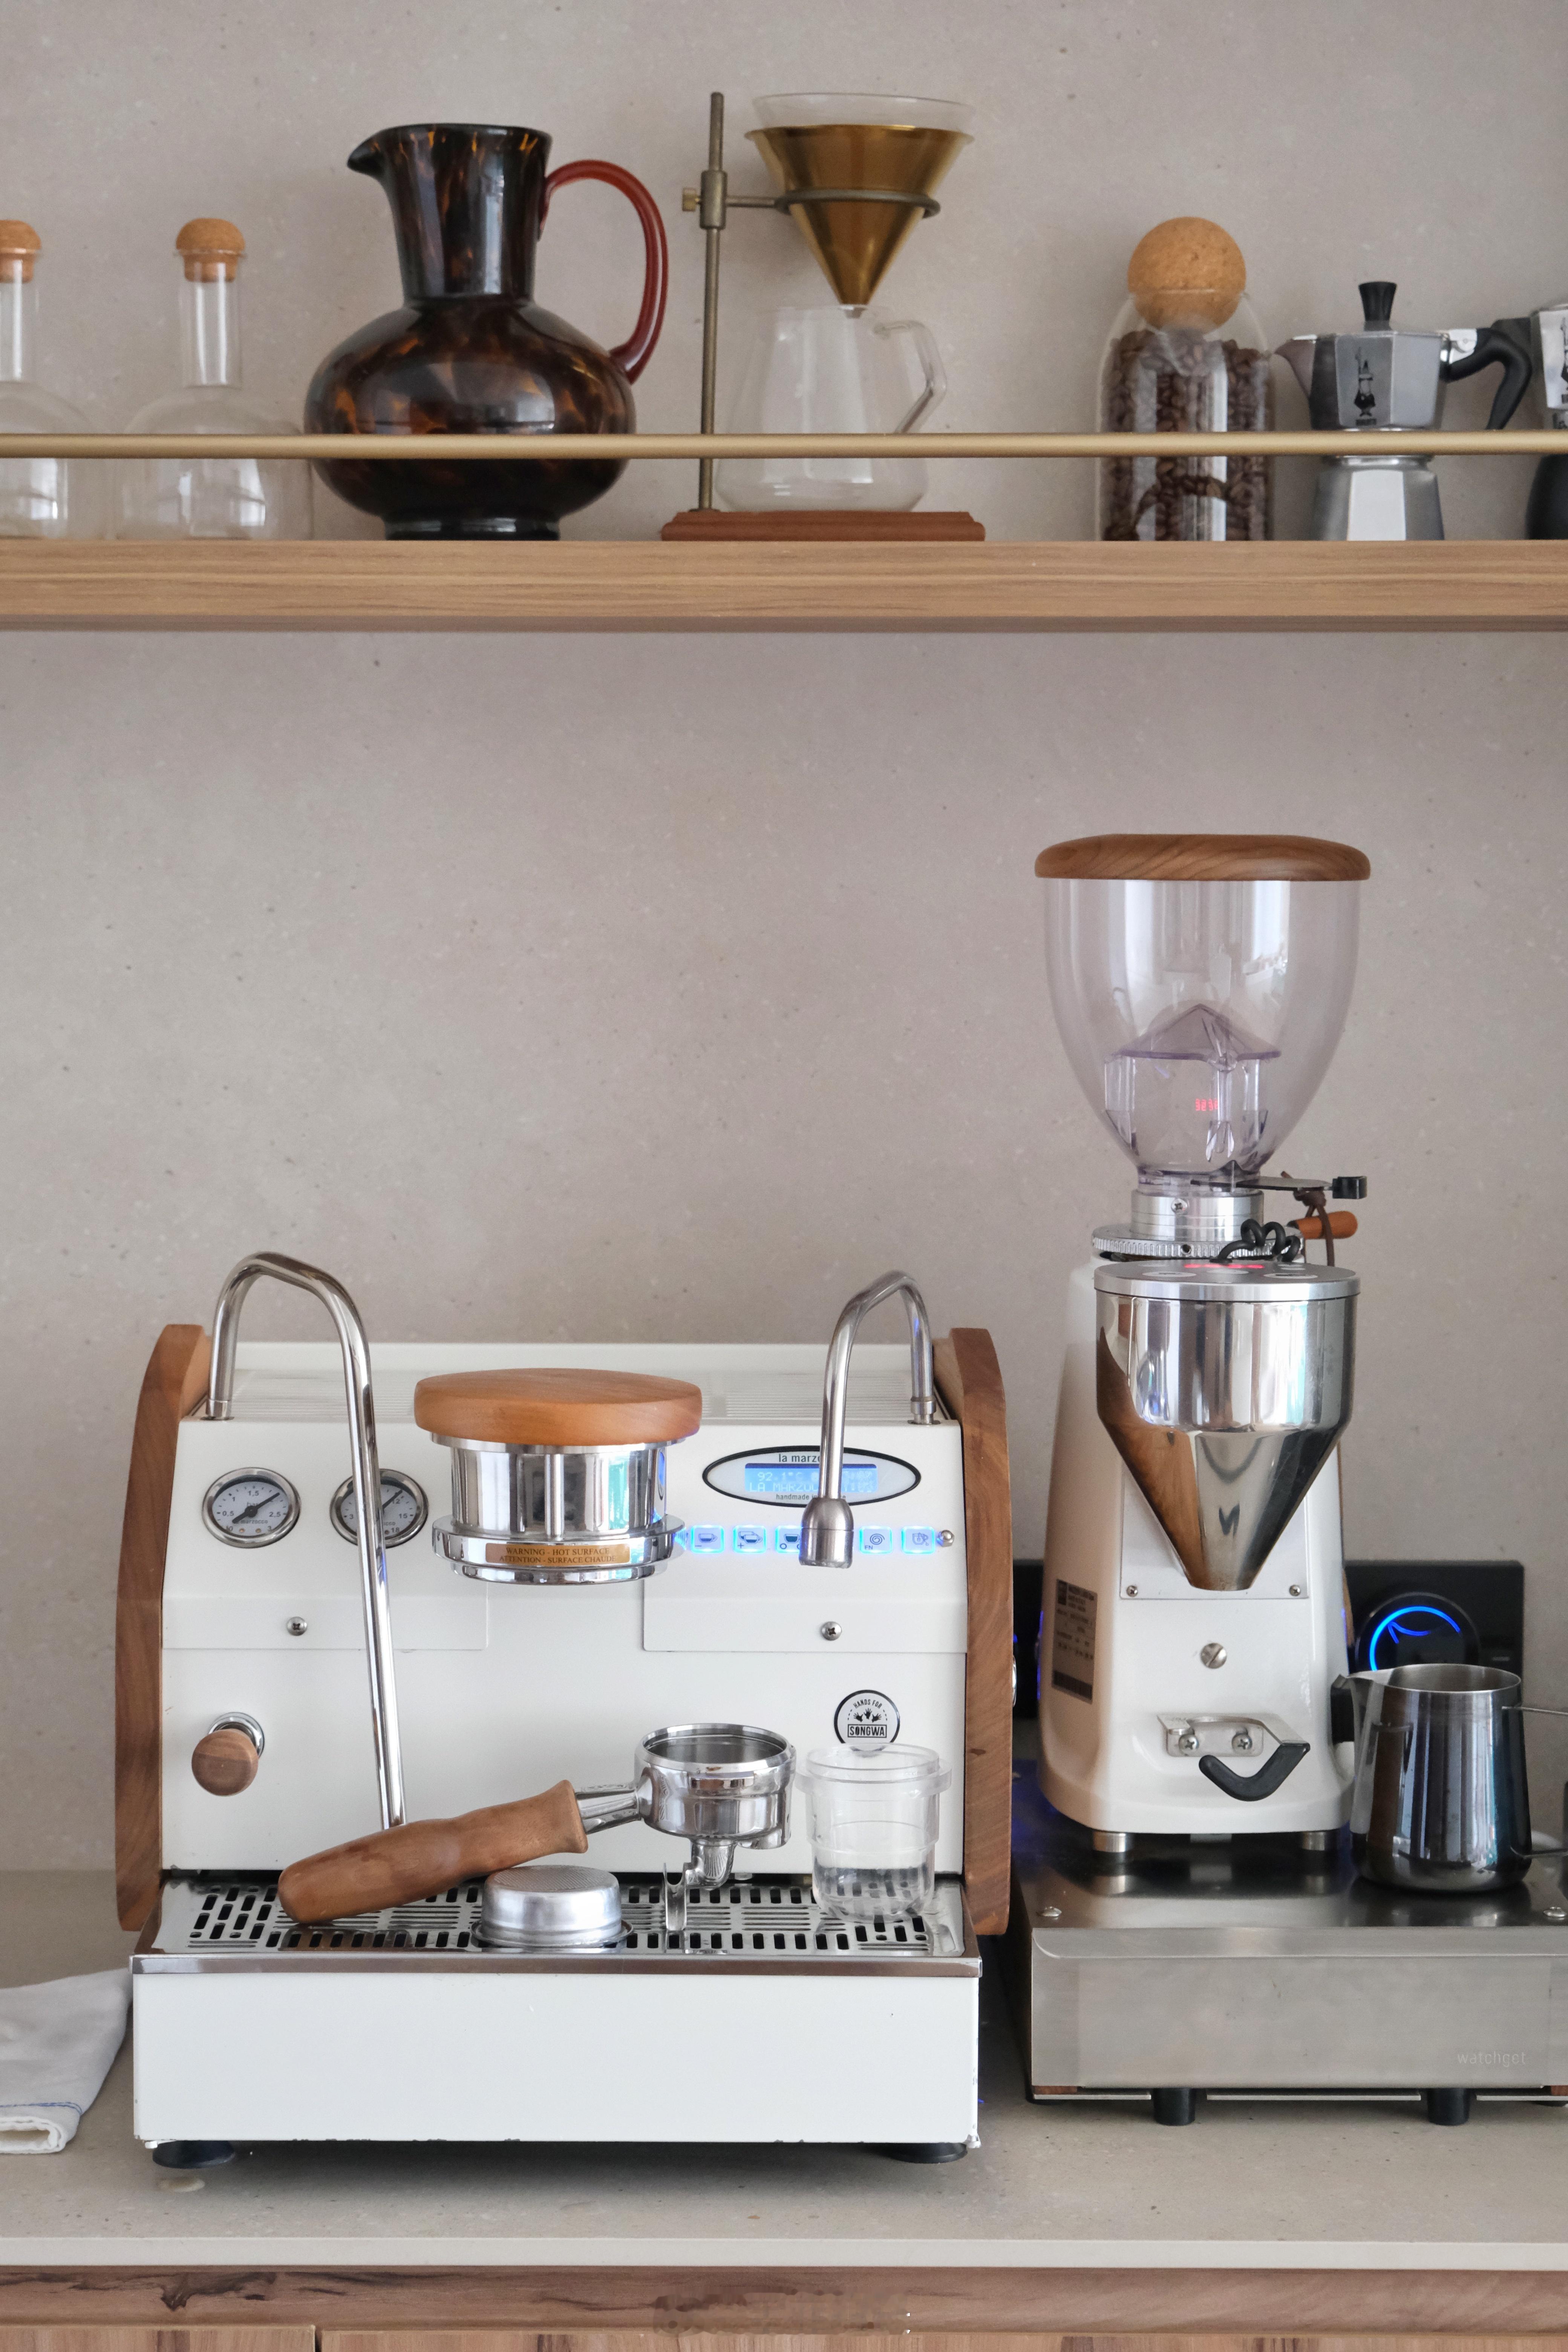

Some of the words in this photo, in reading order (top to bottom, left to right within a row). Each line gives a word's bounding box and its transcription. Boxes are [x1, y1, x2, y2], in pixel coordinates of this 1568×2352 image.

[779, 1453, 787, 1462] la
[506, 1547, 545, 1556] WARNING
[853, 1699, 870, 1709] HANDS
[872, 1700, 882, 1709] FOR
[850, 1726, 885, 1736] SONGWA
